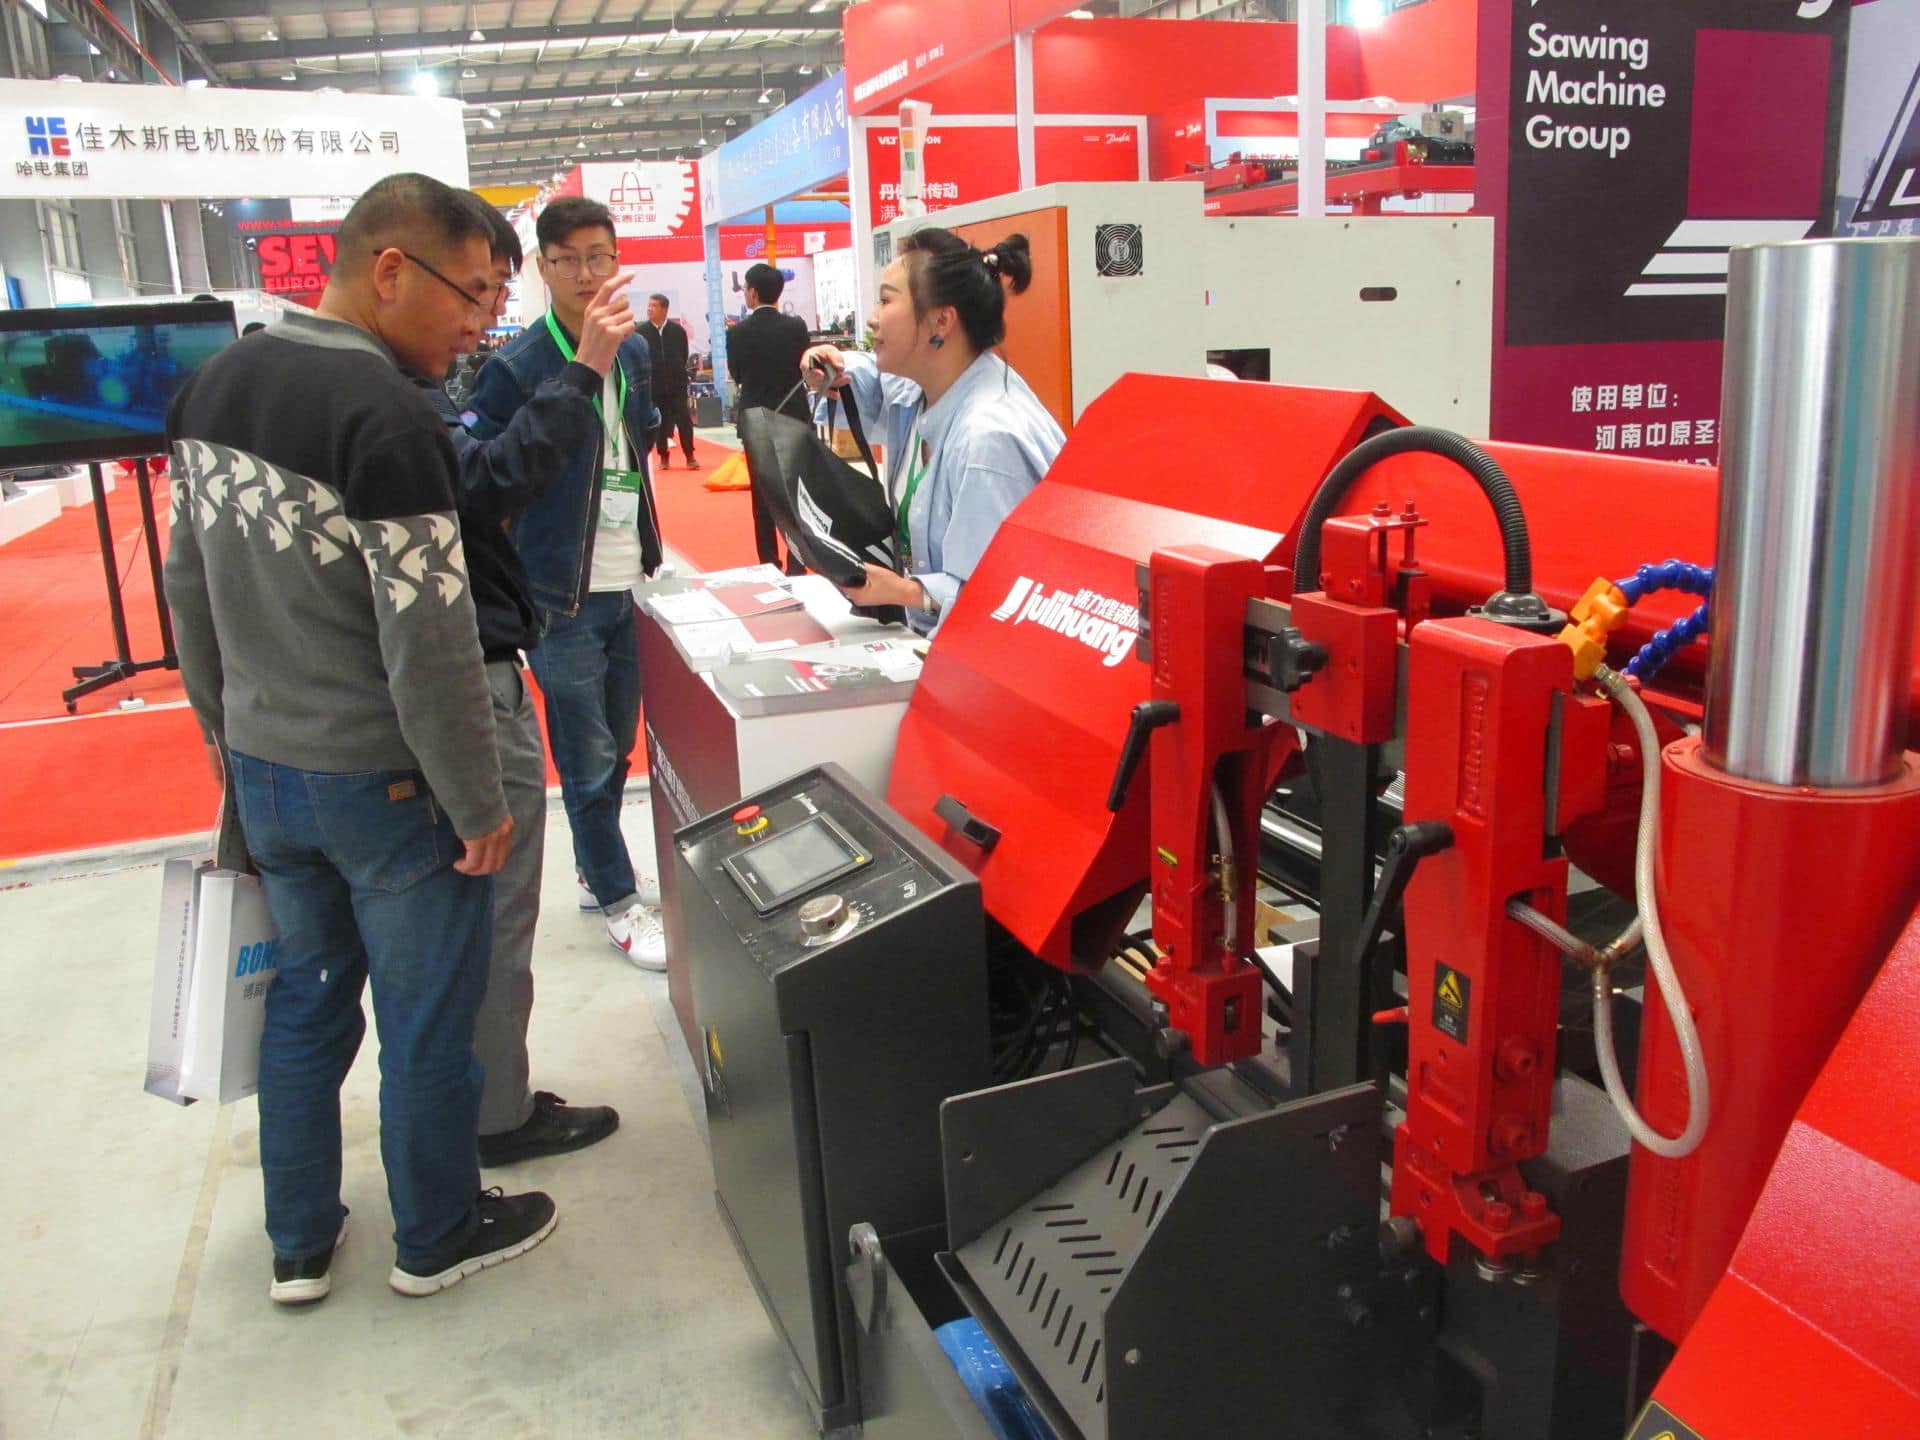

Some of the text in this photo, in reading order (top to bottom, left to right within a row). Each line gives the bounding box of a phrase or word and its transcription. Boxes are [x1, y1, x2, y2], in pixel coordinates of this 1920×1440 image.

[1528, 23, 1648, 70] Sawing
[1526, 70, 1666, 107] Machine
[75, 122, 400, 154] 佳木斯电机股份有限公司
[1526, 114, 1631, 159] Group
[16, 160, 89, 177] 哈电集团
[1595, 419, 1721, 451] 河南中原圣
